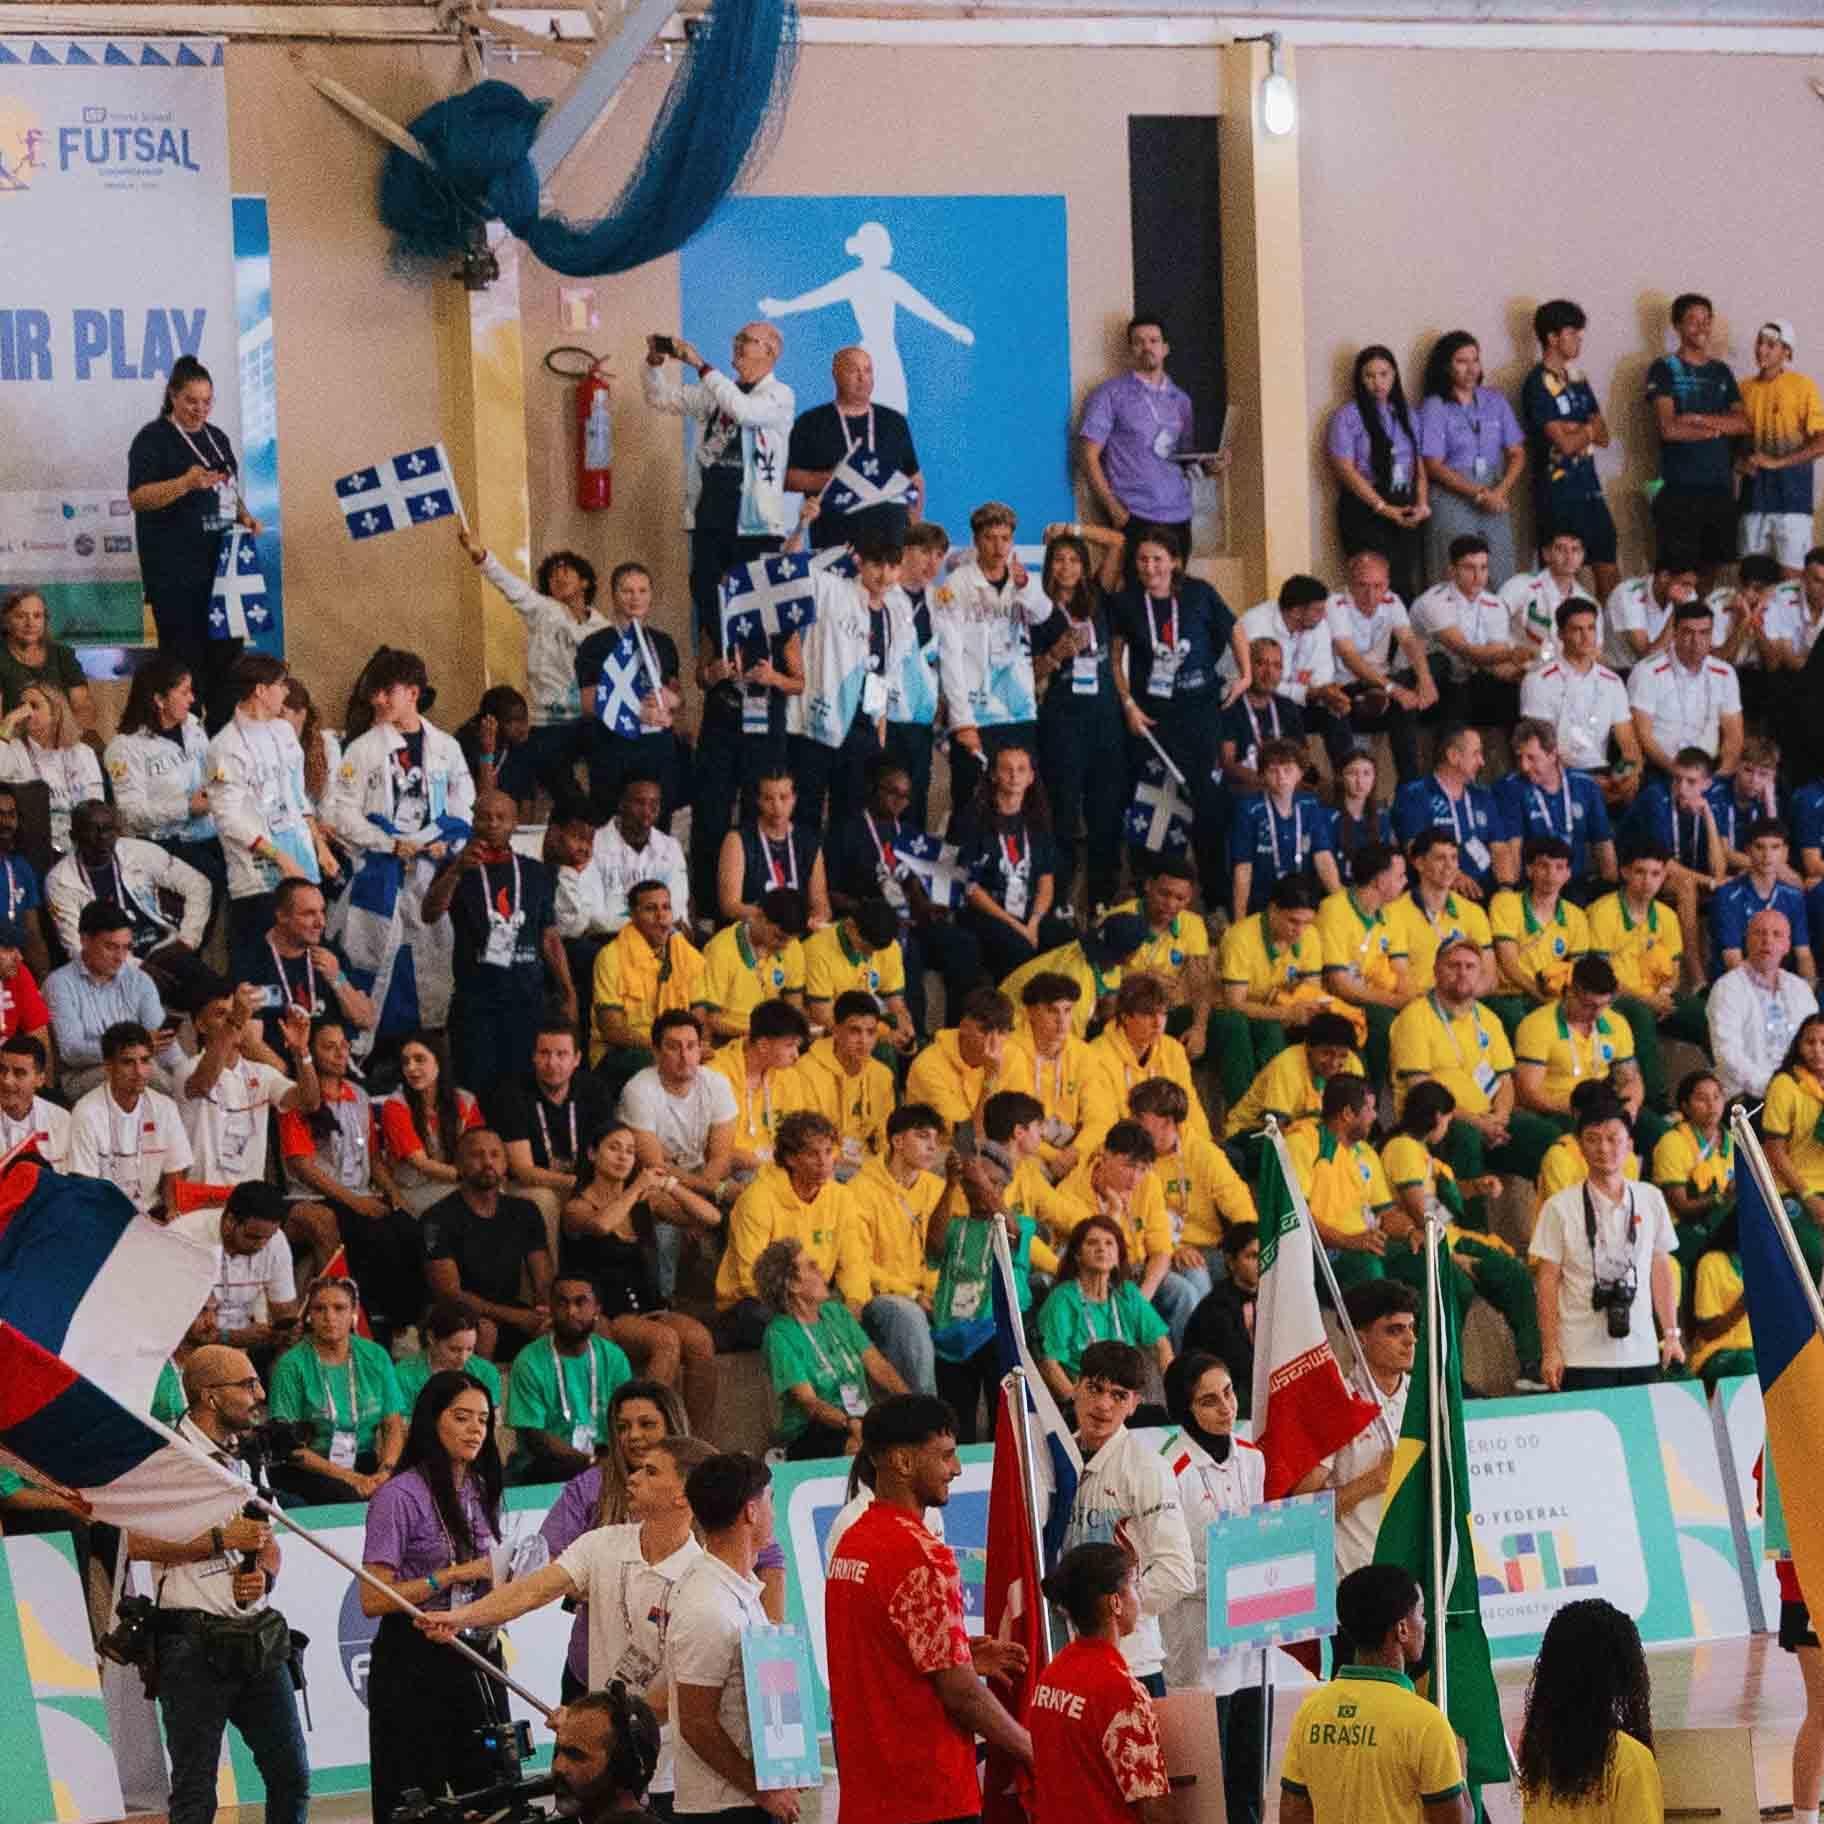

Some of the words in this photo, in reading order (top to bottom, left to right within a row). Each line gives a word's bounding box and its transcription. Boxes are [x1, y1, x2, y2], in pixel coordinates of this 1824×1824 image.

[59, 127, 200, 172] FUTSAL
[73, 308, 207, 381] PLAY
[1493, 1506, 1570, 1525] FEDERAL
[1310, 1723, 1377, 1747] BRASIL
